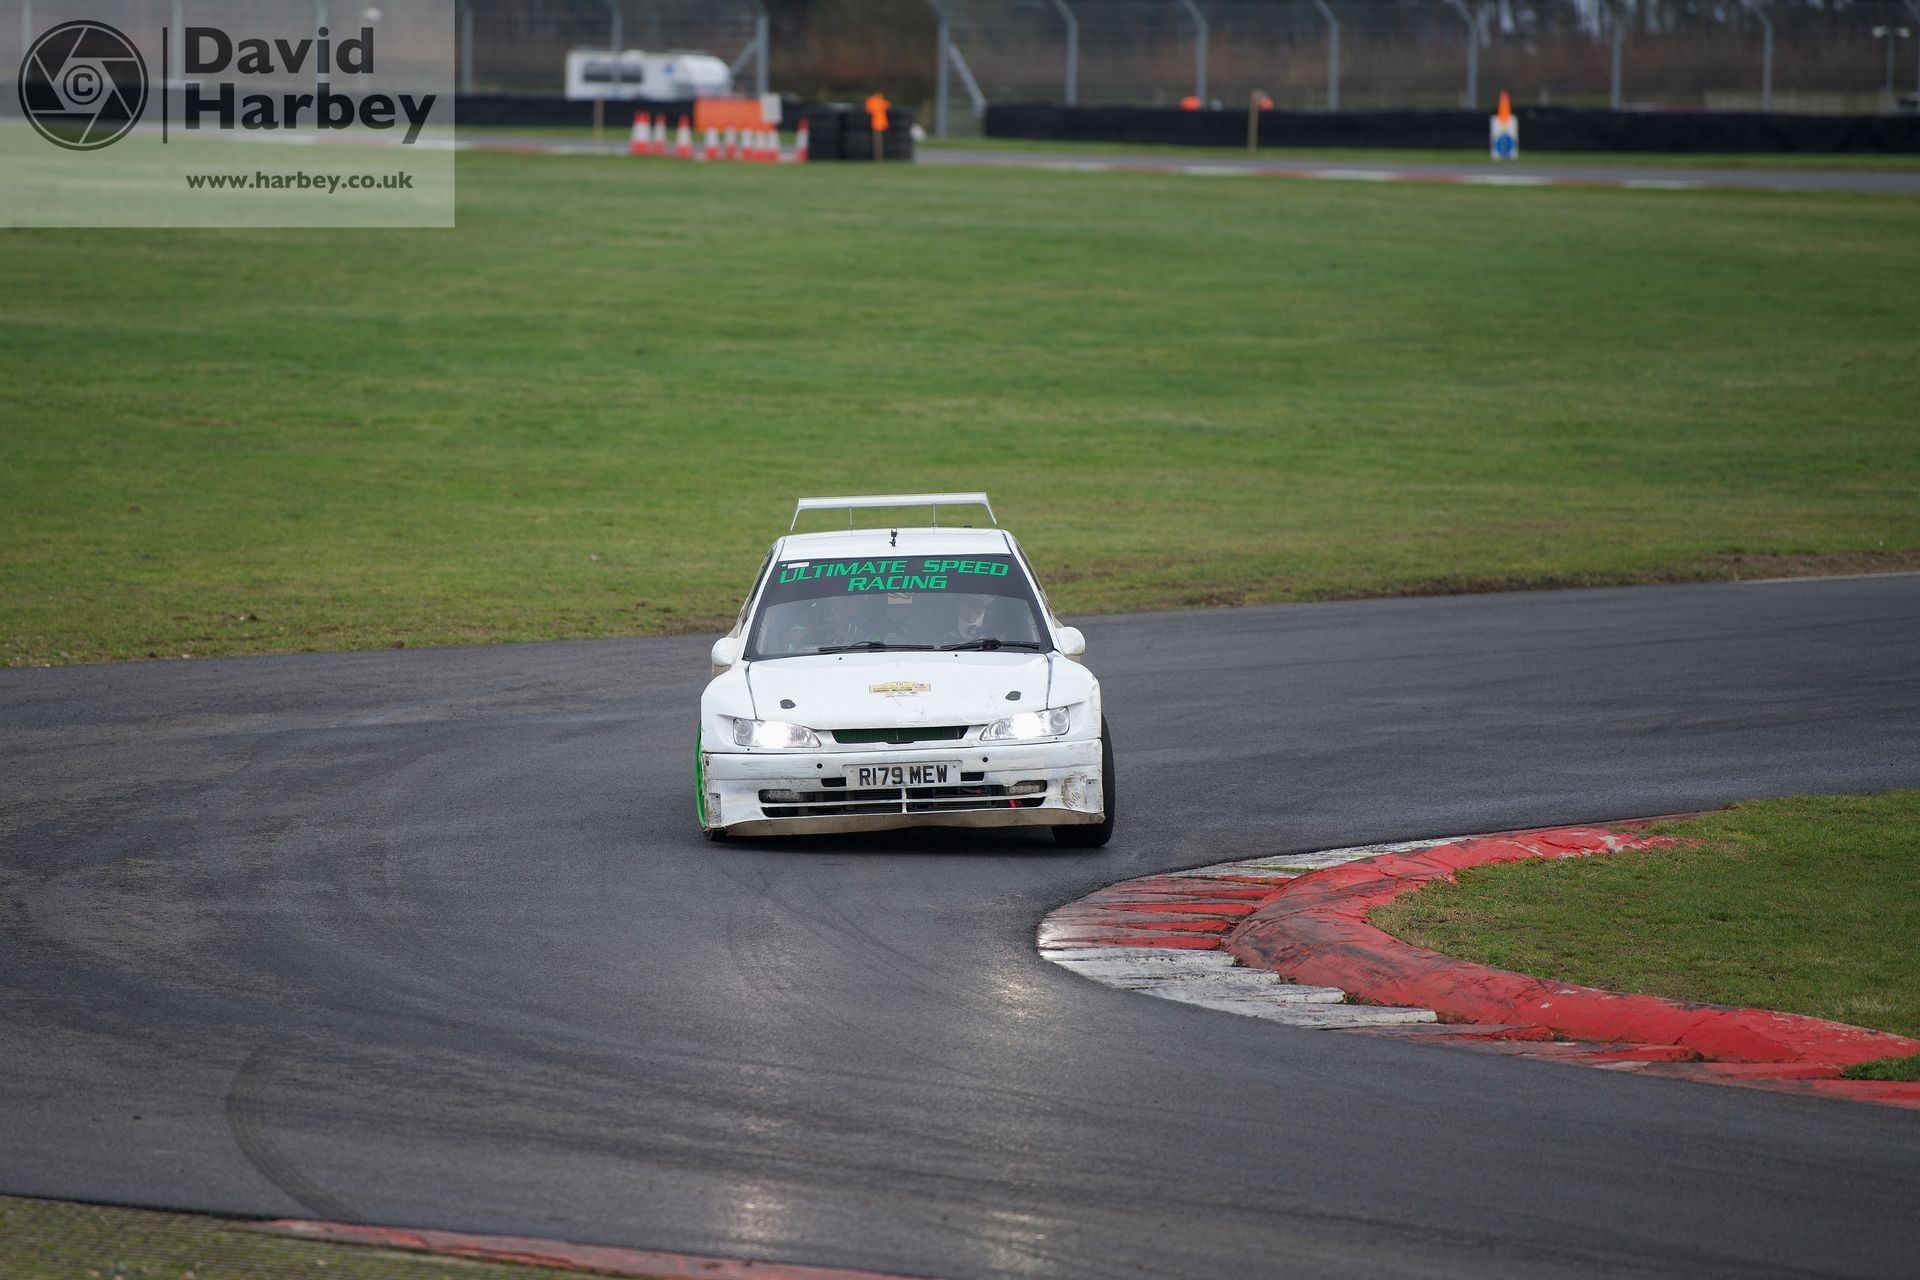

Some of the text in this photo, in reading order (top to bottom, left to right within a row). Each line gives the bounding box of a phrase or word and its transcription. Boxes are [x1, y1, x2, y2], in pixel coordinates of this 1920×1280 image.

[779, 560, 1009, 584] ULTIMATE SPEED
[847, 575, 948, 592] RACING
[859, 764, 948, 787] R179 MEW
